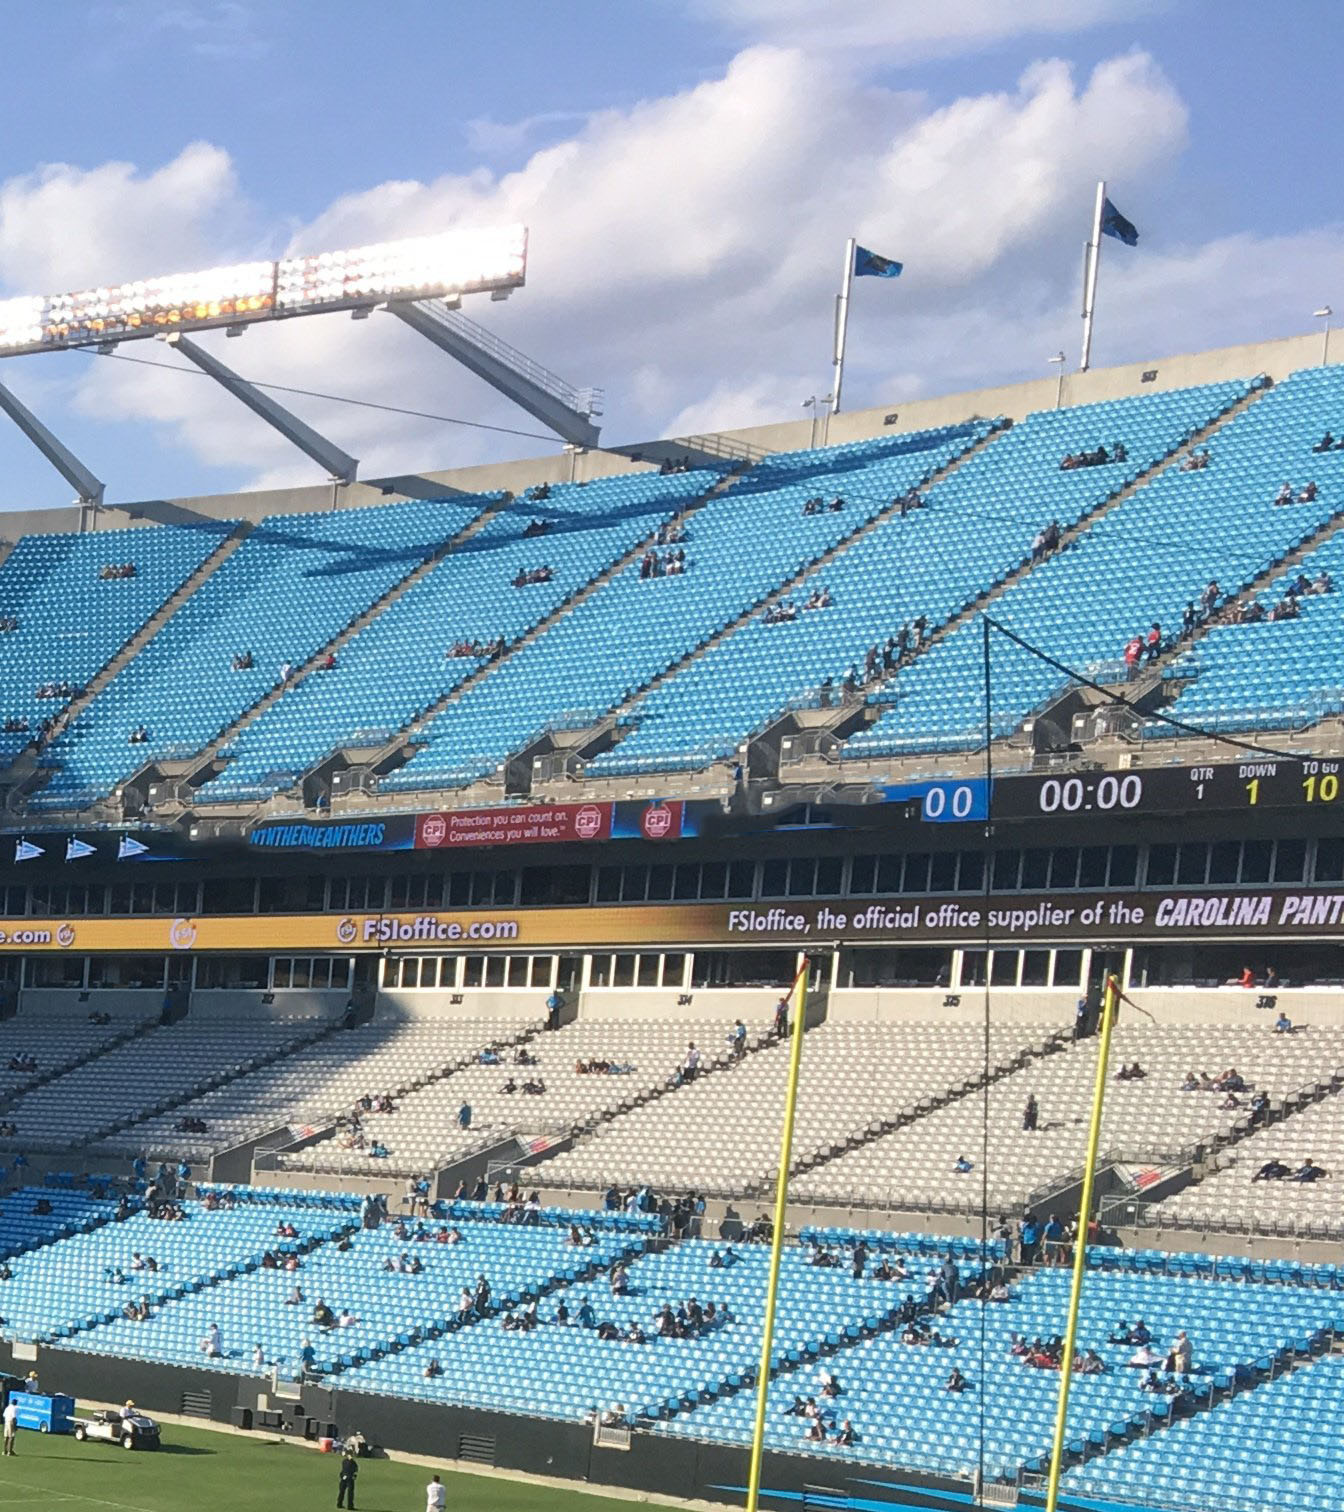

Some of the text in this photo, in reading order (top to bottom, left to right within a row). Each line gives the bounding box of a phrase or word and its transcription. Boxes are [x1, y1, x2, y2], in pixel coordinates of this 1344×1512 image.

[1190, 767, 1215, 781] QTR
[1238, 763, 1277, 779] DOWN
[1302, 761, 1319, 775] TO
[1039, 774, 1143, 813] 00:00
[1195, 783, 1204, 800] 1
[1245, 778, 1259, 805] 1
[1302, 775, 1339, 802] 10
[925, 785, 973, 819] 0 0
[450, 813, 491, 827] Protection
[493, 814, 509, 828] you
[510, 815, 526, 824] can
[527, 812, 552, 823] count
[576, 816, 600, 827] CPI
[646, 815, 670, 827] CPI
[423, 825, 446, 836] CPI
[449, 829, 505, 842] Conveniences
[506, 830, 522, 841] you
[523, 827, 539, 838] will
[728, 908, 811, 934] FSIoffice,
[817, 907, 847, 930] the
[853, 905, 919, 928] official
[925, 904, 980, 928] office
[987, 902, 1074, 932] supplier
[1080, 900, 1105, 925] of
[1109, 900, 1144, 925] the
[1155, 896, 1272, 927] CAROLINA
[364, 917, 518, 942] FSIoffice.com
